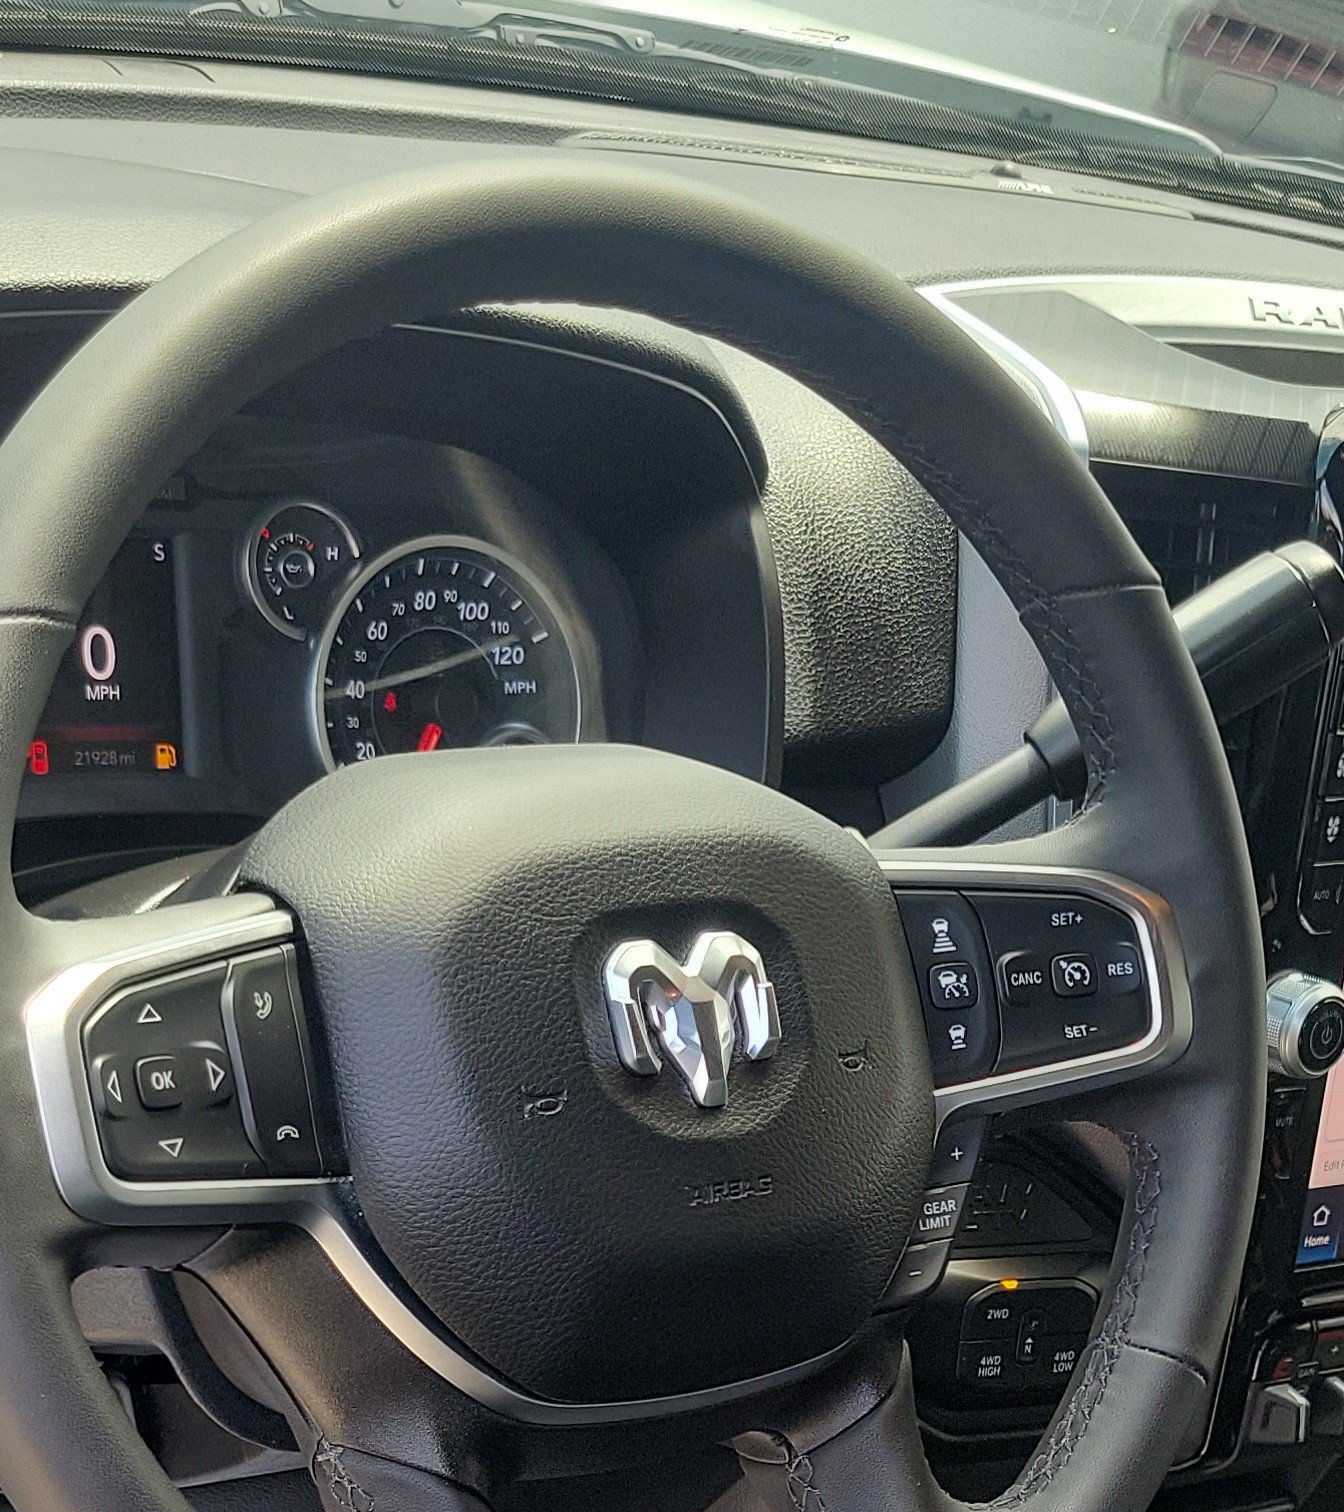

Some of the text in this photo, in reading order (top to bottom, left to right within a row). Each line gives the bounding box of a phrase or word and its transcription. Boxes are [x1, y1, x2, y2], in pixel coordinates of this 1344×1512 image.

[154, 543, 165, 562] S
[326, 547, 338, 561] H
[413, 591, 436, 611] 80
[443, 590, 458, 603] 90
[283, 606, 294, 620] L
[392, 603, 405, 616] 70
[457, 602, 489, 621] 100
[367, 621, 388, 641] 60
[491, 622, 510, 635] 110
[81, 625, 116, 681] 0
[355, 651, 367, 663] 50
[491, 647, 525, 666] 120
[85, 685, 121, 701] MPH
[345, 680, 365, 700] 40
[504, 681, 537, 695] MPH
[346, 717, 360, 730] 30
[356, 742, 376, 761] 20
[1313, 890, 1331, 901] AUTO
[1051, 911, 1083, 927] SET+
[1107, 963, 1134, 977] RES
[1010, 971, 1043, 987] CANC
[151, 1070, 176, 1091] OK
[1275, 1116, 1294, 1127] MUTE
[1323, 1160, 1340, 1172] Edit
[923, 1199, 957, 1216] GEAR
[919, 1214, 952, 1231] LIMIT
[1304, 1235, 1330, 1248] Home
[987, 1308, 1010, 1320] 2WD
[1024, 1344, 1032, 1354] N
[980, 1355, 1002, 1367] 4WD
[1054, 1351, 1075, 1362] 4WD
[978, 1365, 1001, 1377] HIGH
[1052, 1361, 1074, 1373] LOW
